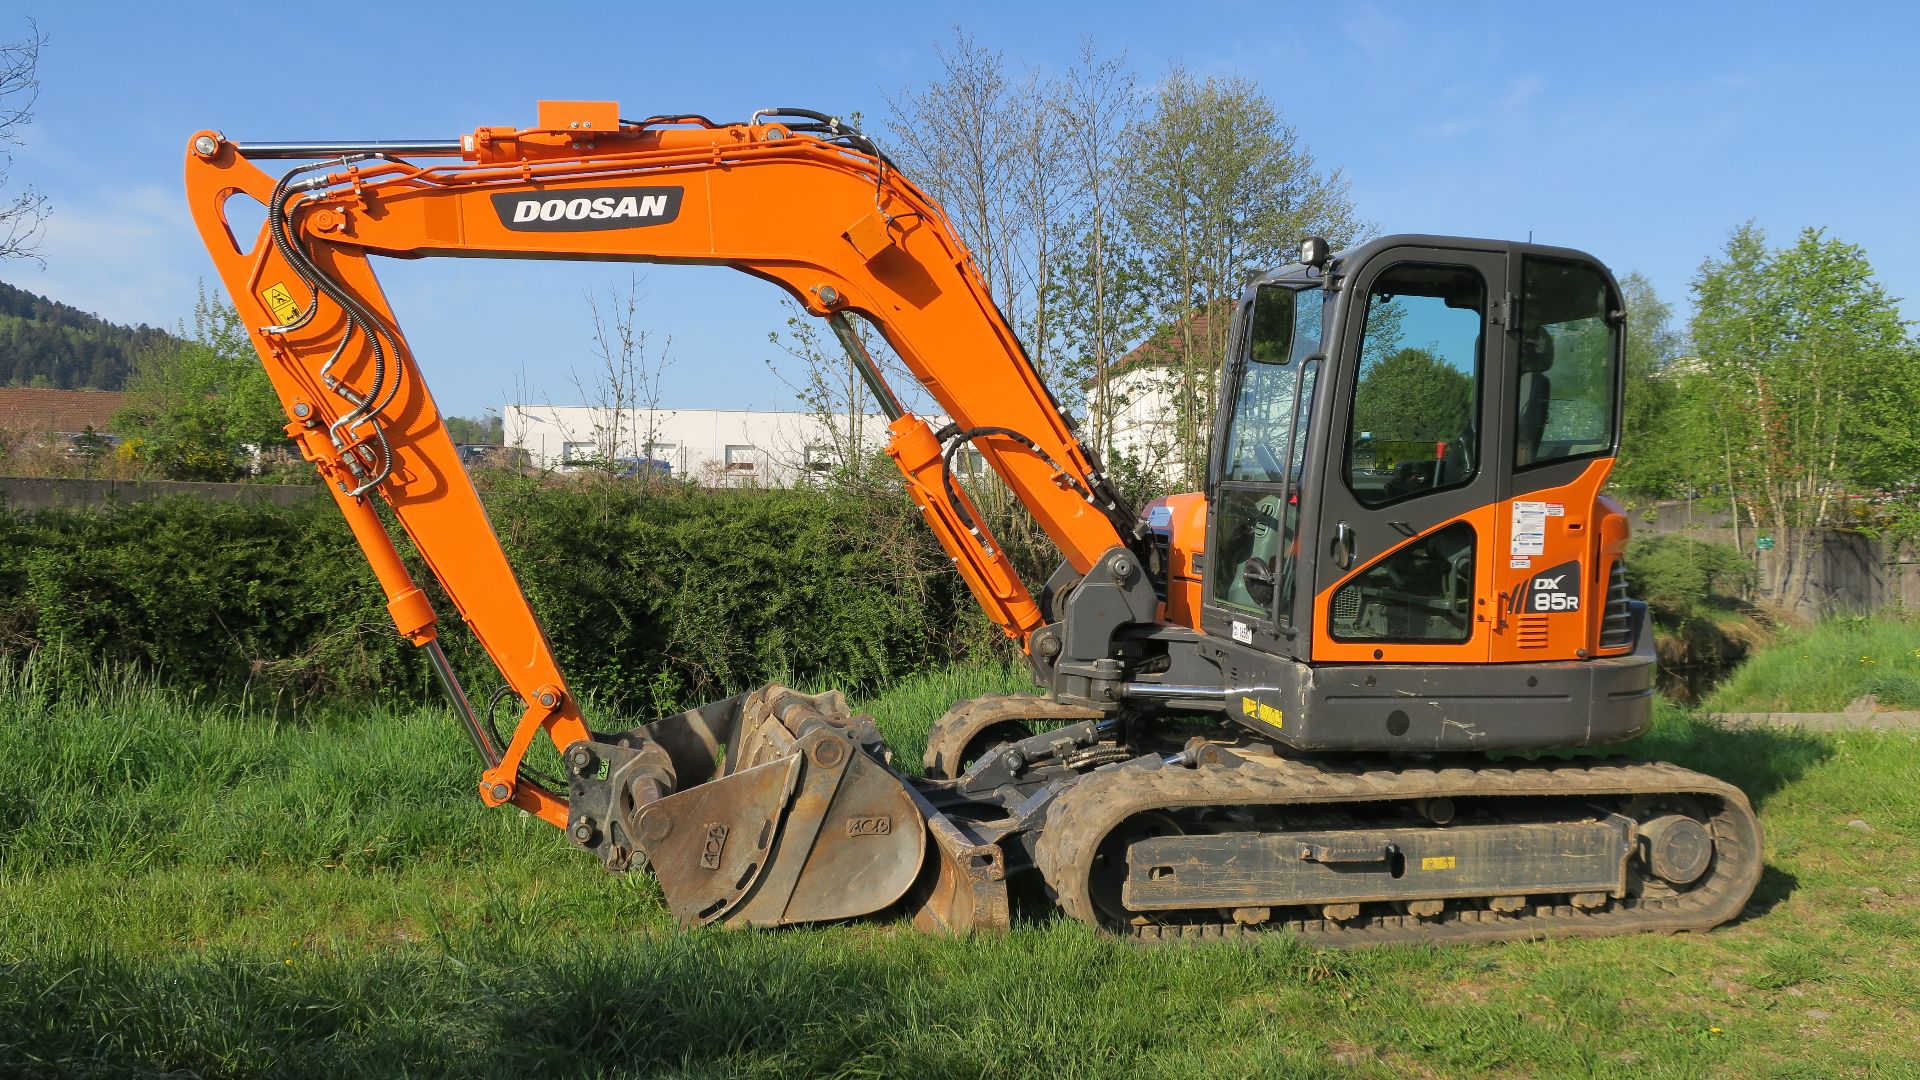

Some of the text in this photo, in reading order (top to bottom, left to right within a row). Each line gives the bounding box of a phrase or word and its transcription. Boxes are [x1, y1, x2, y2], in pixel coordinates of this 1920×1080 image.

[513, 195, 668, 223] DOOSAN
[1534, 574, 1567, 590] DX
[1535, 592, 1579, 611] 85R
[849, 818, 889, 834] ACB
